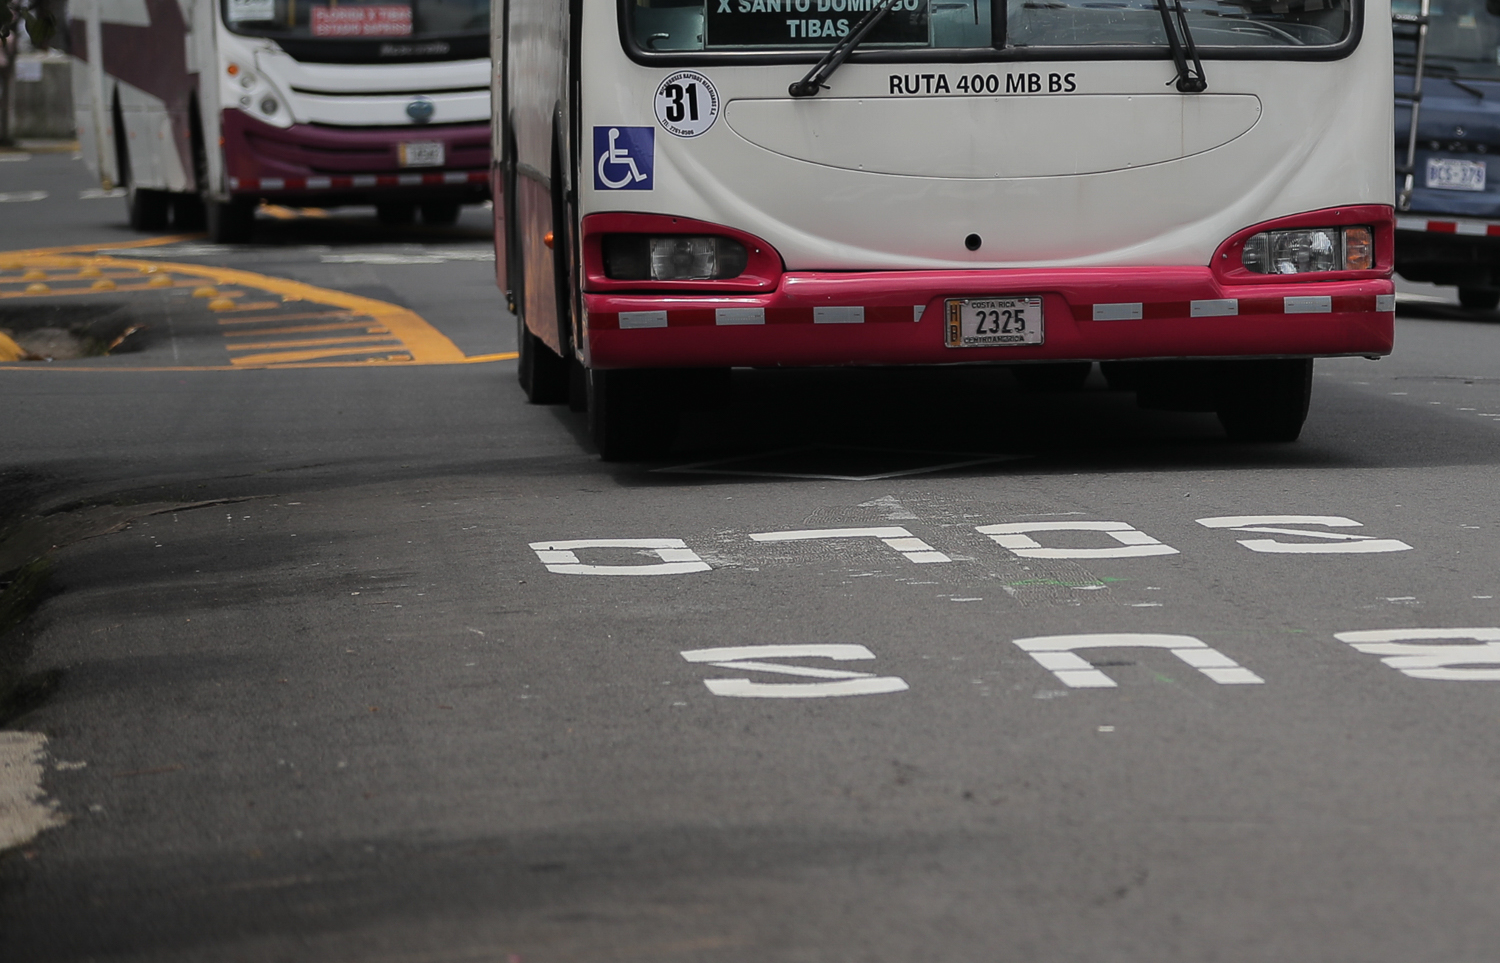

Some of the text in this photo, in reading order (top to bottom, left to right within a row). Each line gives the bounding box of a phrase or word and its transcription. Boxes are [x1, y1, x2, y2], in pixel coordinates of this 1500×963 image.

[786, 19, 849, 38] TIBAS
[889, 73, 1077, 94] RUTA 400 MB BS
[665, 83, 699, 122] 31
[971, 301, 996, 309] COSTA
[976, 309, 1026, 334] 2325
[529, 514, 1415, 576] SOLO
